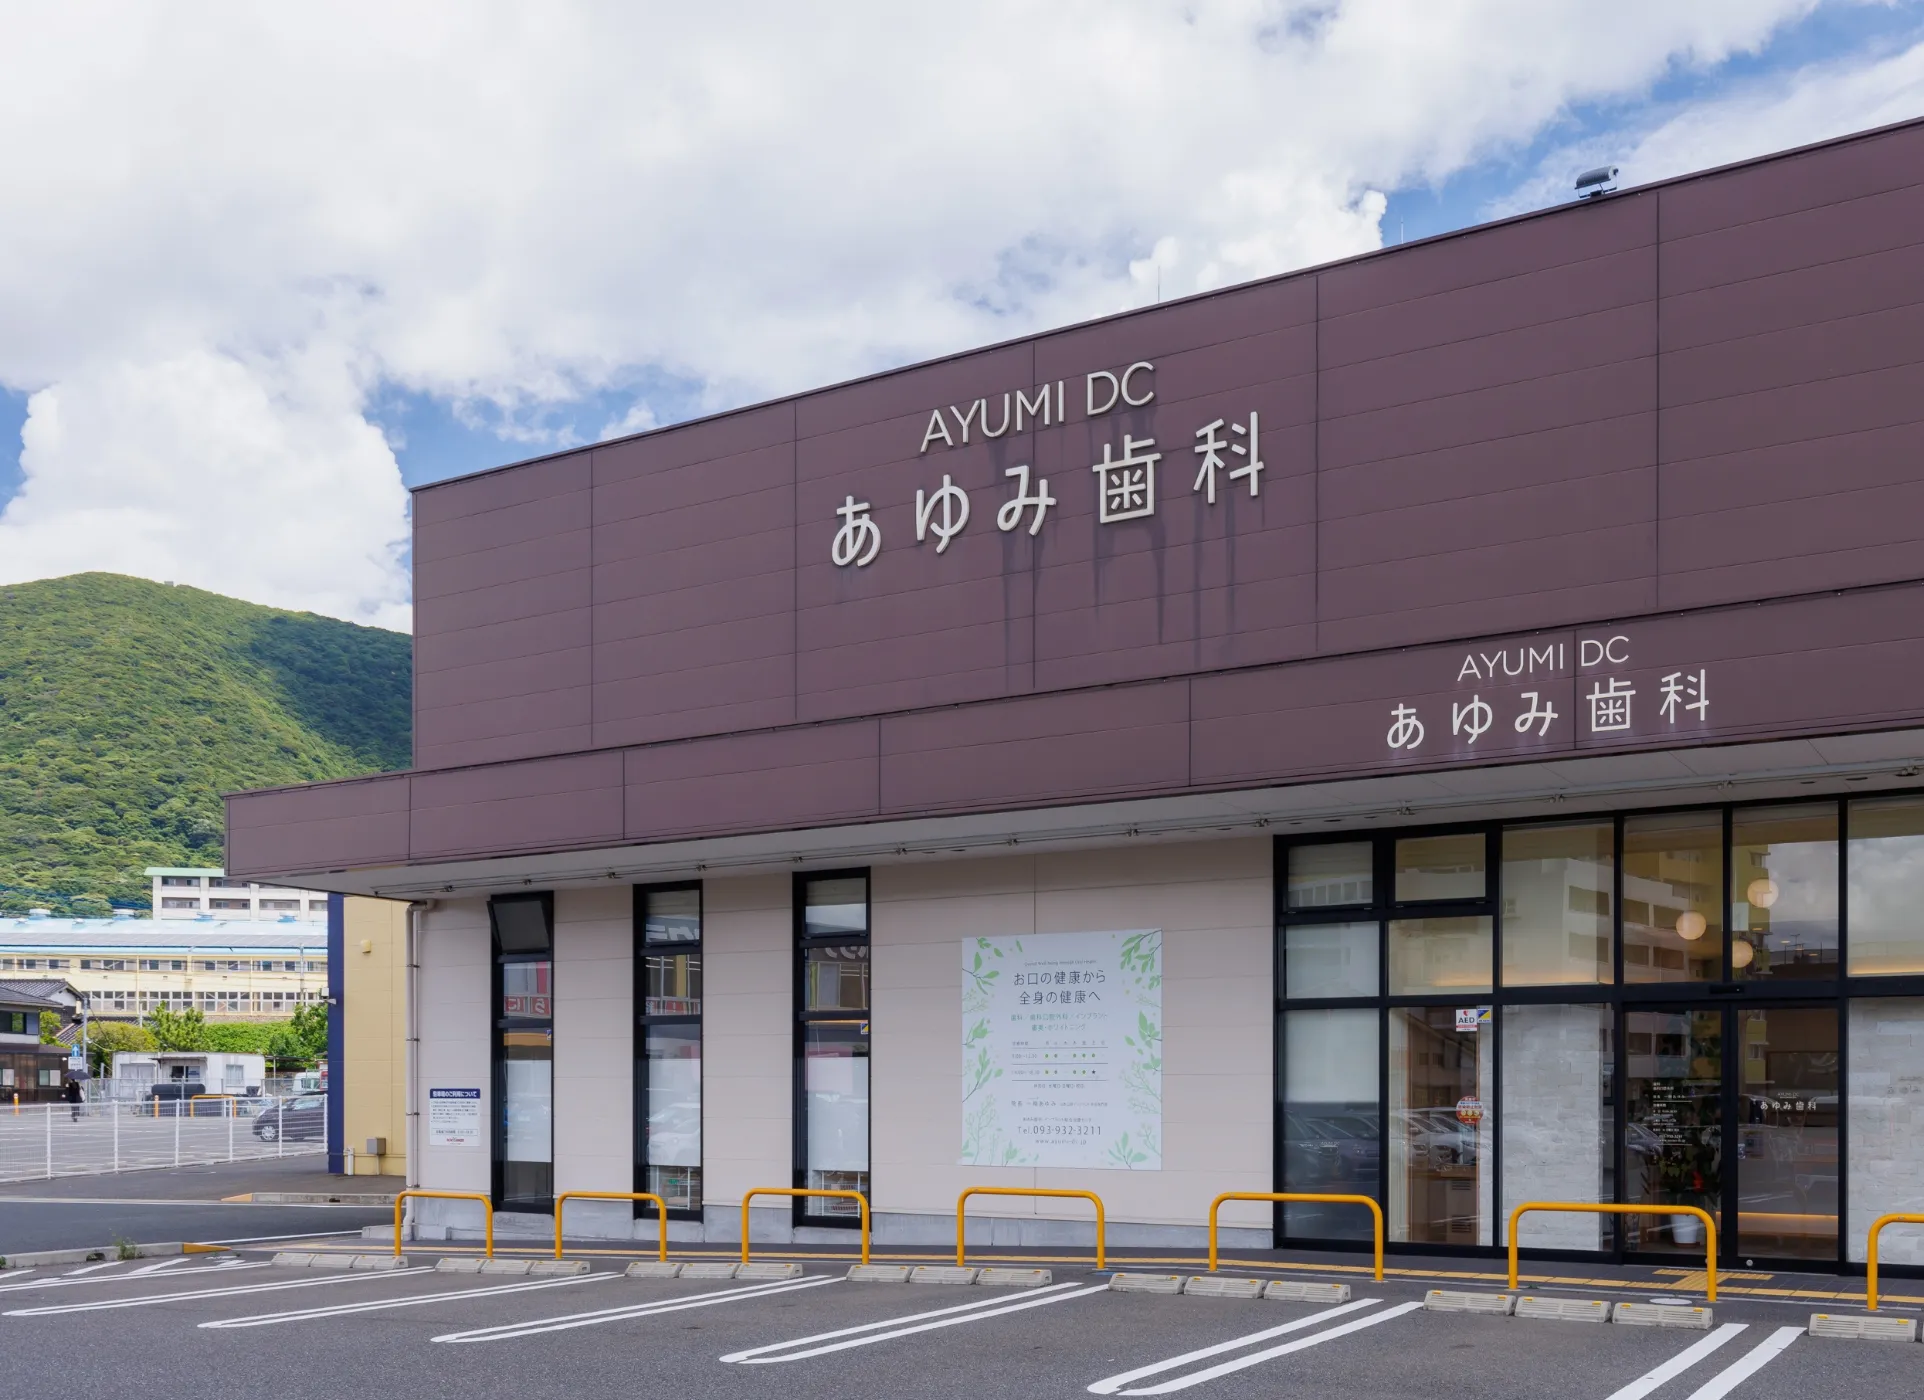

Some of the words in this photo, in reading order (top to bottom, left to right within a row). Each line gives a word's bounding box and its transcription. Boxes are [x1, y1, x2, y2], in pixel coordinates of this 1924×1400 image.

[920, 380, 1065, 453] AYUMI
[1086, 361, 1156, 417] DC
[831, 411, 1265, 567] あゆみ歯科
[1457, 643, 1564, 682] AYUMI
[1581, 635, 1630, 667] DC
[1386, 669, 1710, 750] あゆみ歯科
[1013, 969, 1106, 987] お口の健康から
[1019, 990, 1101, 1006] 全身の健康へ
[1457, 1016, 1475, 1024] AED
[1760, 1100, 1817, 1111] あゆみ歯科
